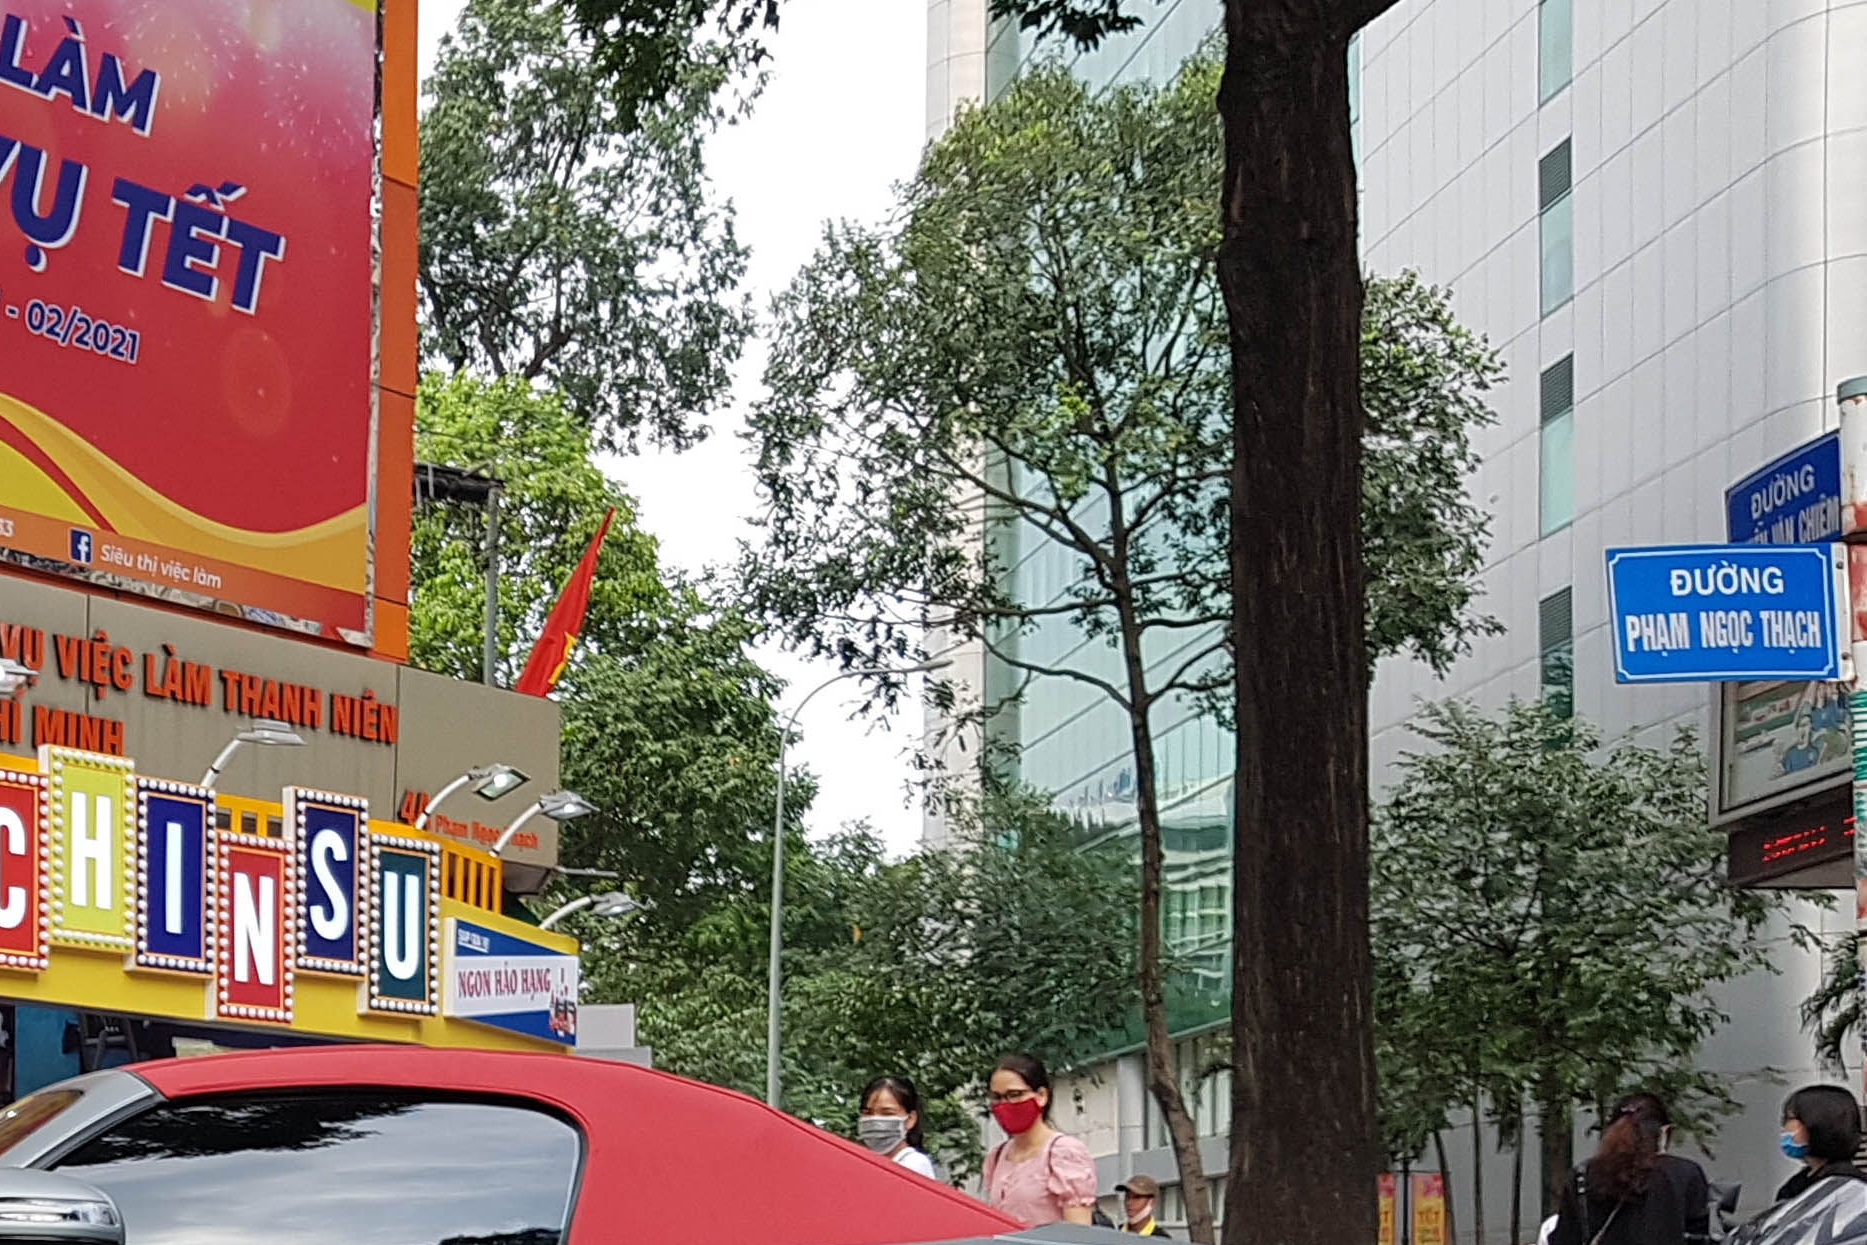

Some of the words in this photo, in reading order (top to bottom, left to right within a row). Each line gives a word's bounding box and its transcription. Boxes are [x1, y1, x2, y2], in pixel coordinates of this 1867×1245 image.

[111, 176, 286, 316] TẾT
[26, 300, 140, 364] 02/2021
[100, 544, 133, 567] Siêu
[193, 564, 222, 589] làm
[1670, 560, 1784, 597] ĐƯỜNG
[1625, 612, 1690, 657] PHẠM
[1700, 610, 1753, 654] NGỌC
[1760, 611, 1822, 655] THẠCH
[55, 630, 133, 700] VIỆC
[145, 643, 212, 707] LÀM
[219, 670, 323, 729] THANH
[330, 688, 398, 745] NIÊN
[33, 704, 124, 757] MINH
[458, 970, 490, 998] NGON
[521, 968, 551, 1001] HẠNG
